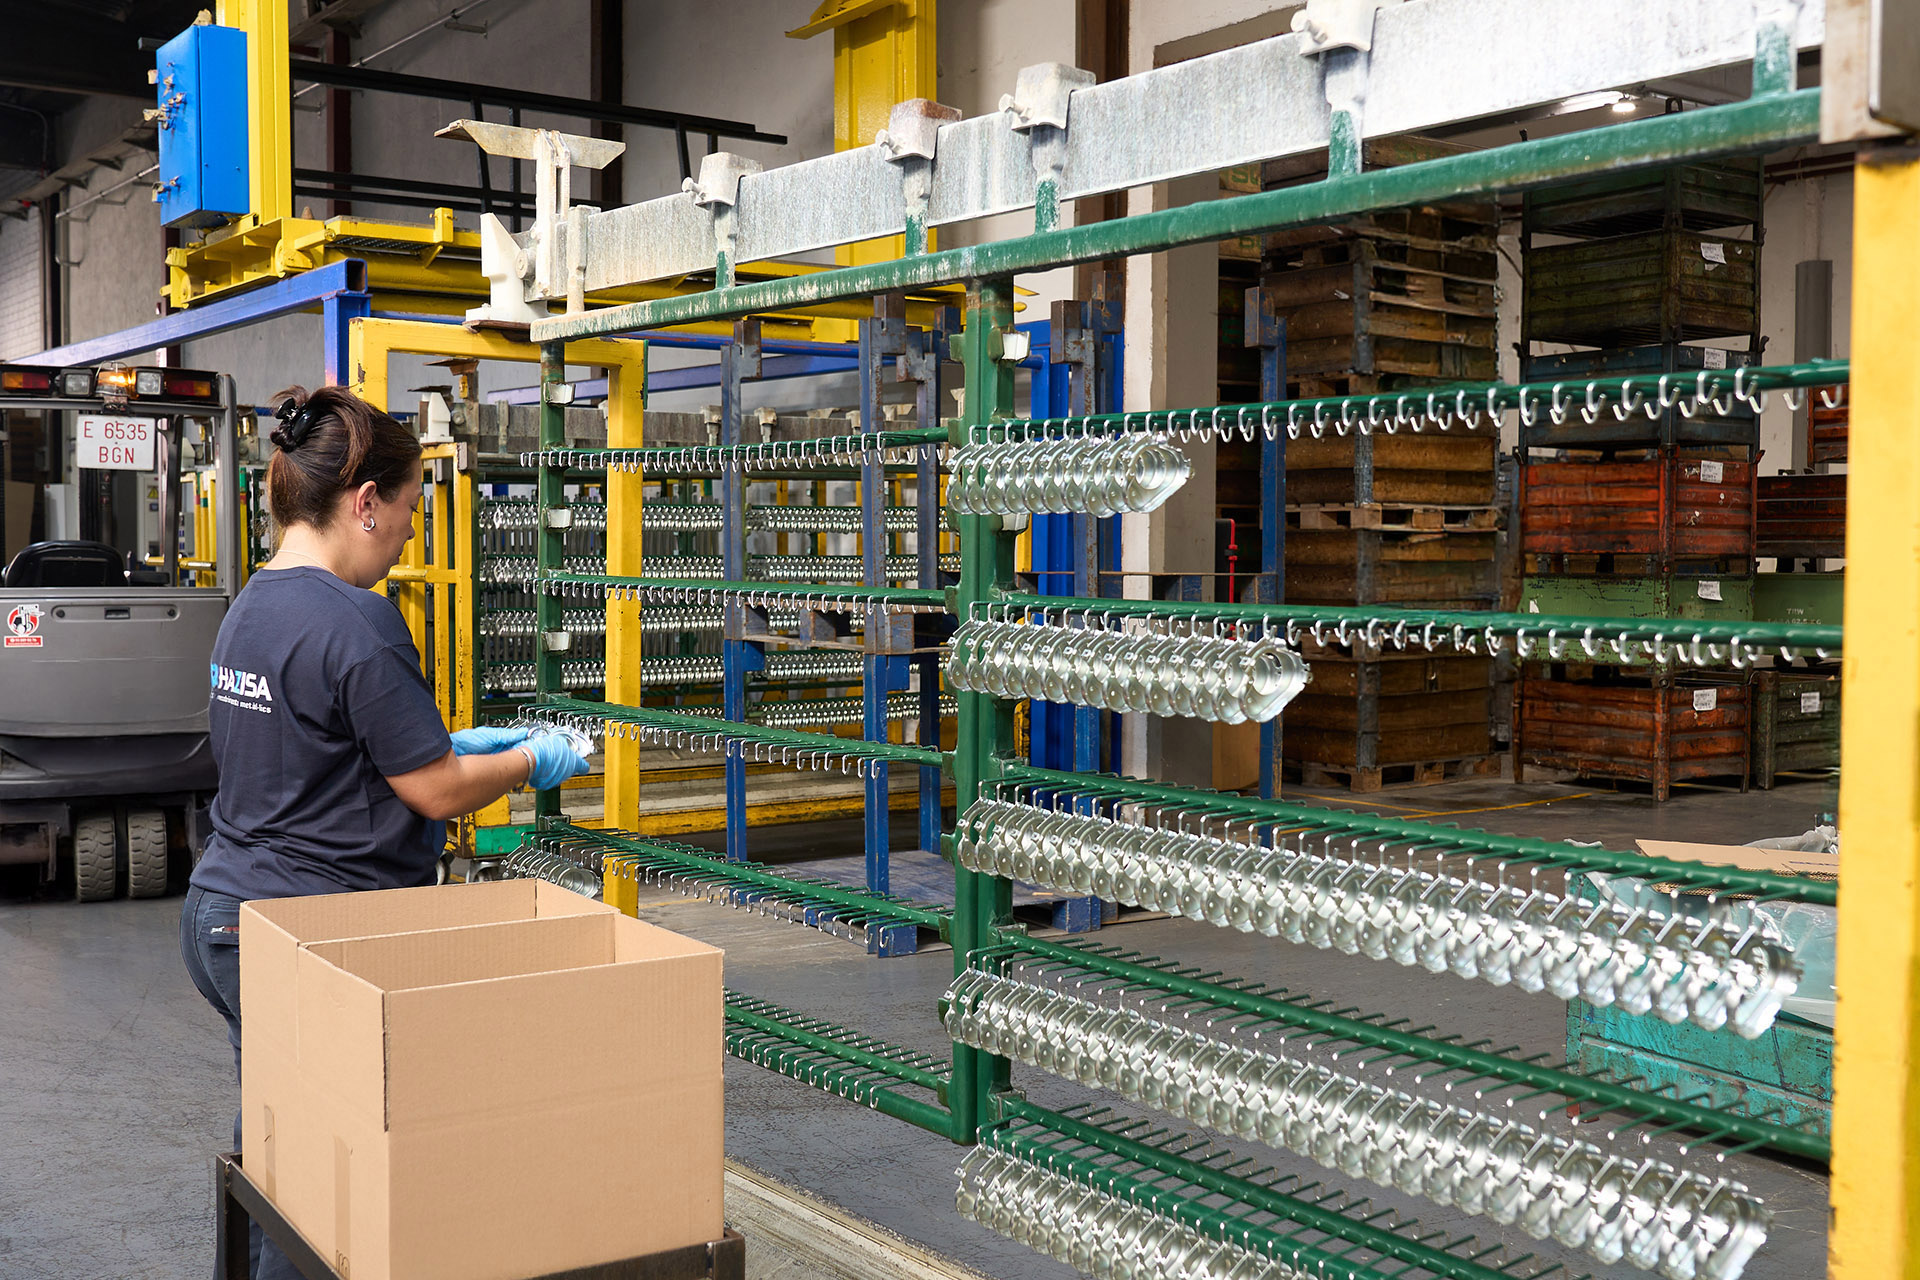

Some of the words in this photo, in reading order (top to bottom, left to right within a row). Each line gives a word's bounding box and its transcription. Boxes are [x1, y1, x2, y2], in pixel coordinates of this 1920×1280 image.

[84, 421, 94, 438] E
[104, 422, 147, 440] 6535
[99, 446, 135, 464] BGN
[217, 666, 273, 702] HAZISA
